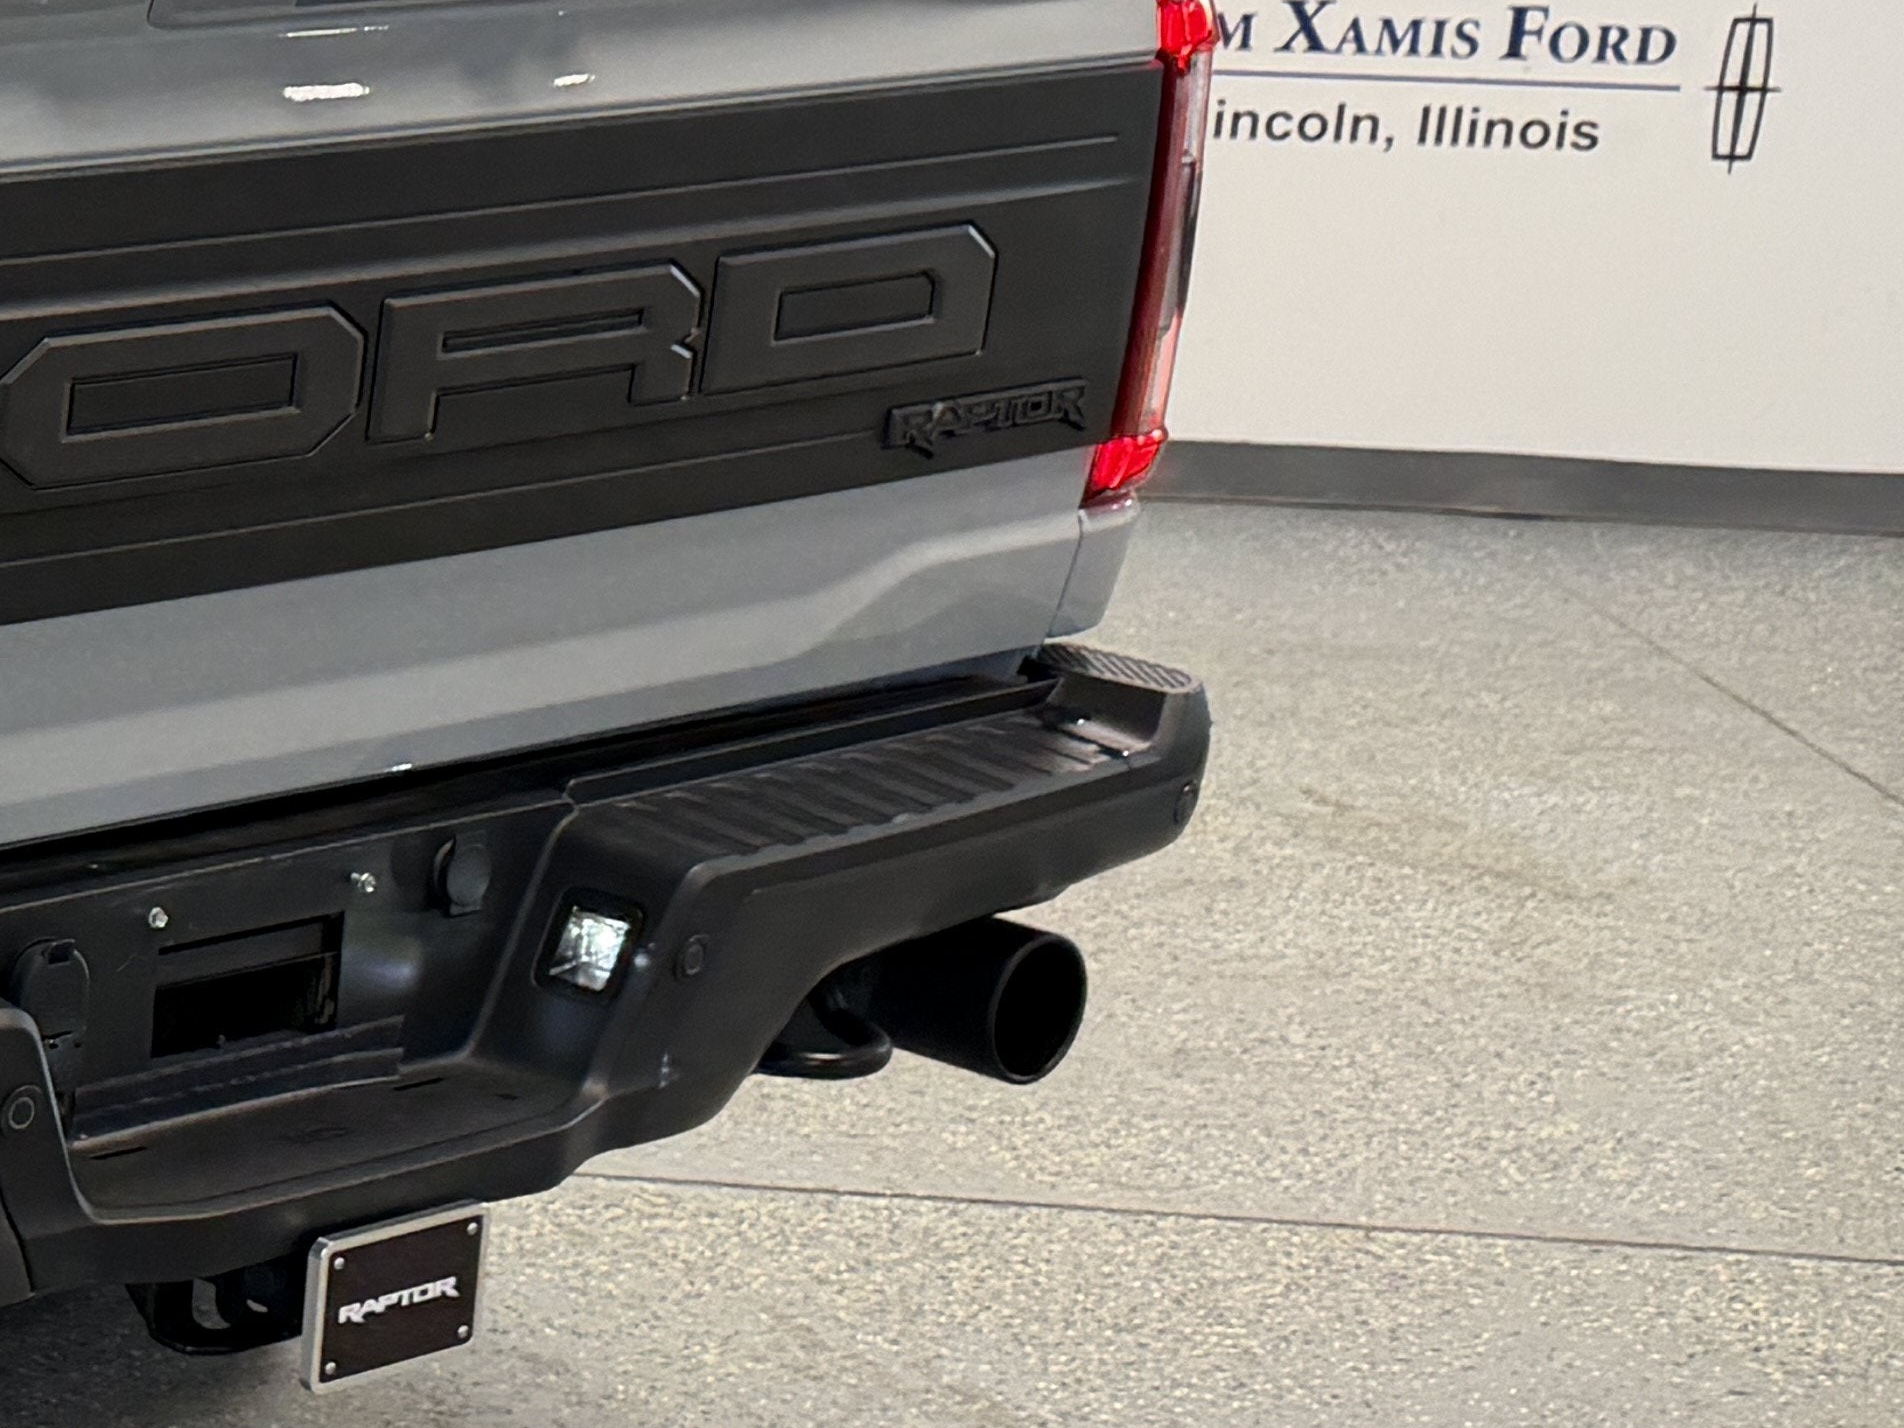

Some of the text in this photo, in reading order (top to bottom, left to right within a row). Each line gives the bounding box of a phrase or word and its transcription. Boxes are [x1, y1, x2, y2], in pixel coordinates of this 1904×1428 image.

[1210, 98, 1600, 153] incoln, Illinois
[882, 378, 1088, 458] RAPTOR
[338, 1275, 461, 1324] RAPTOR
